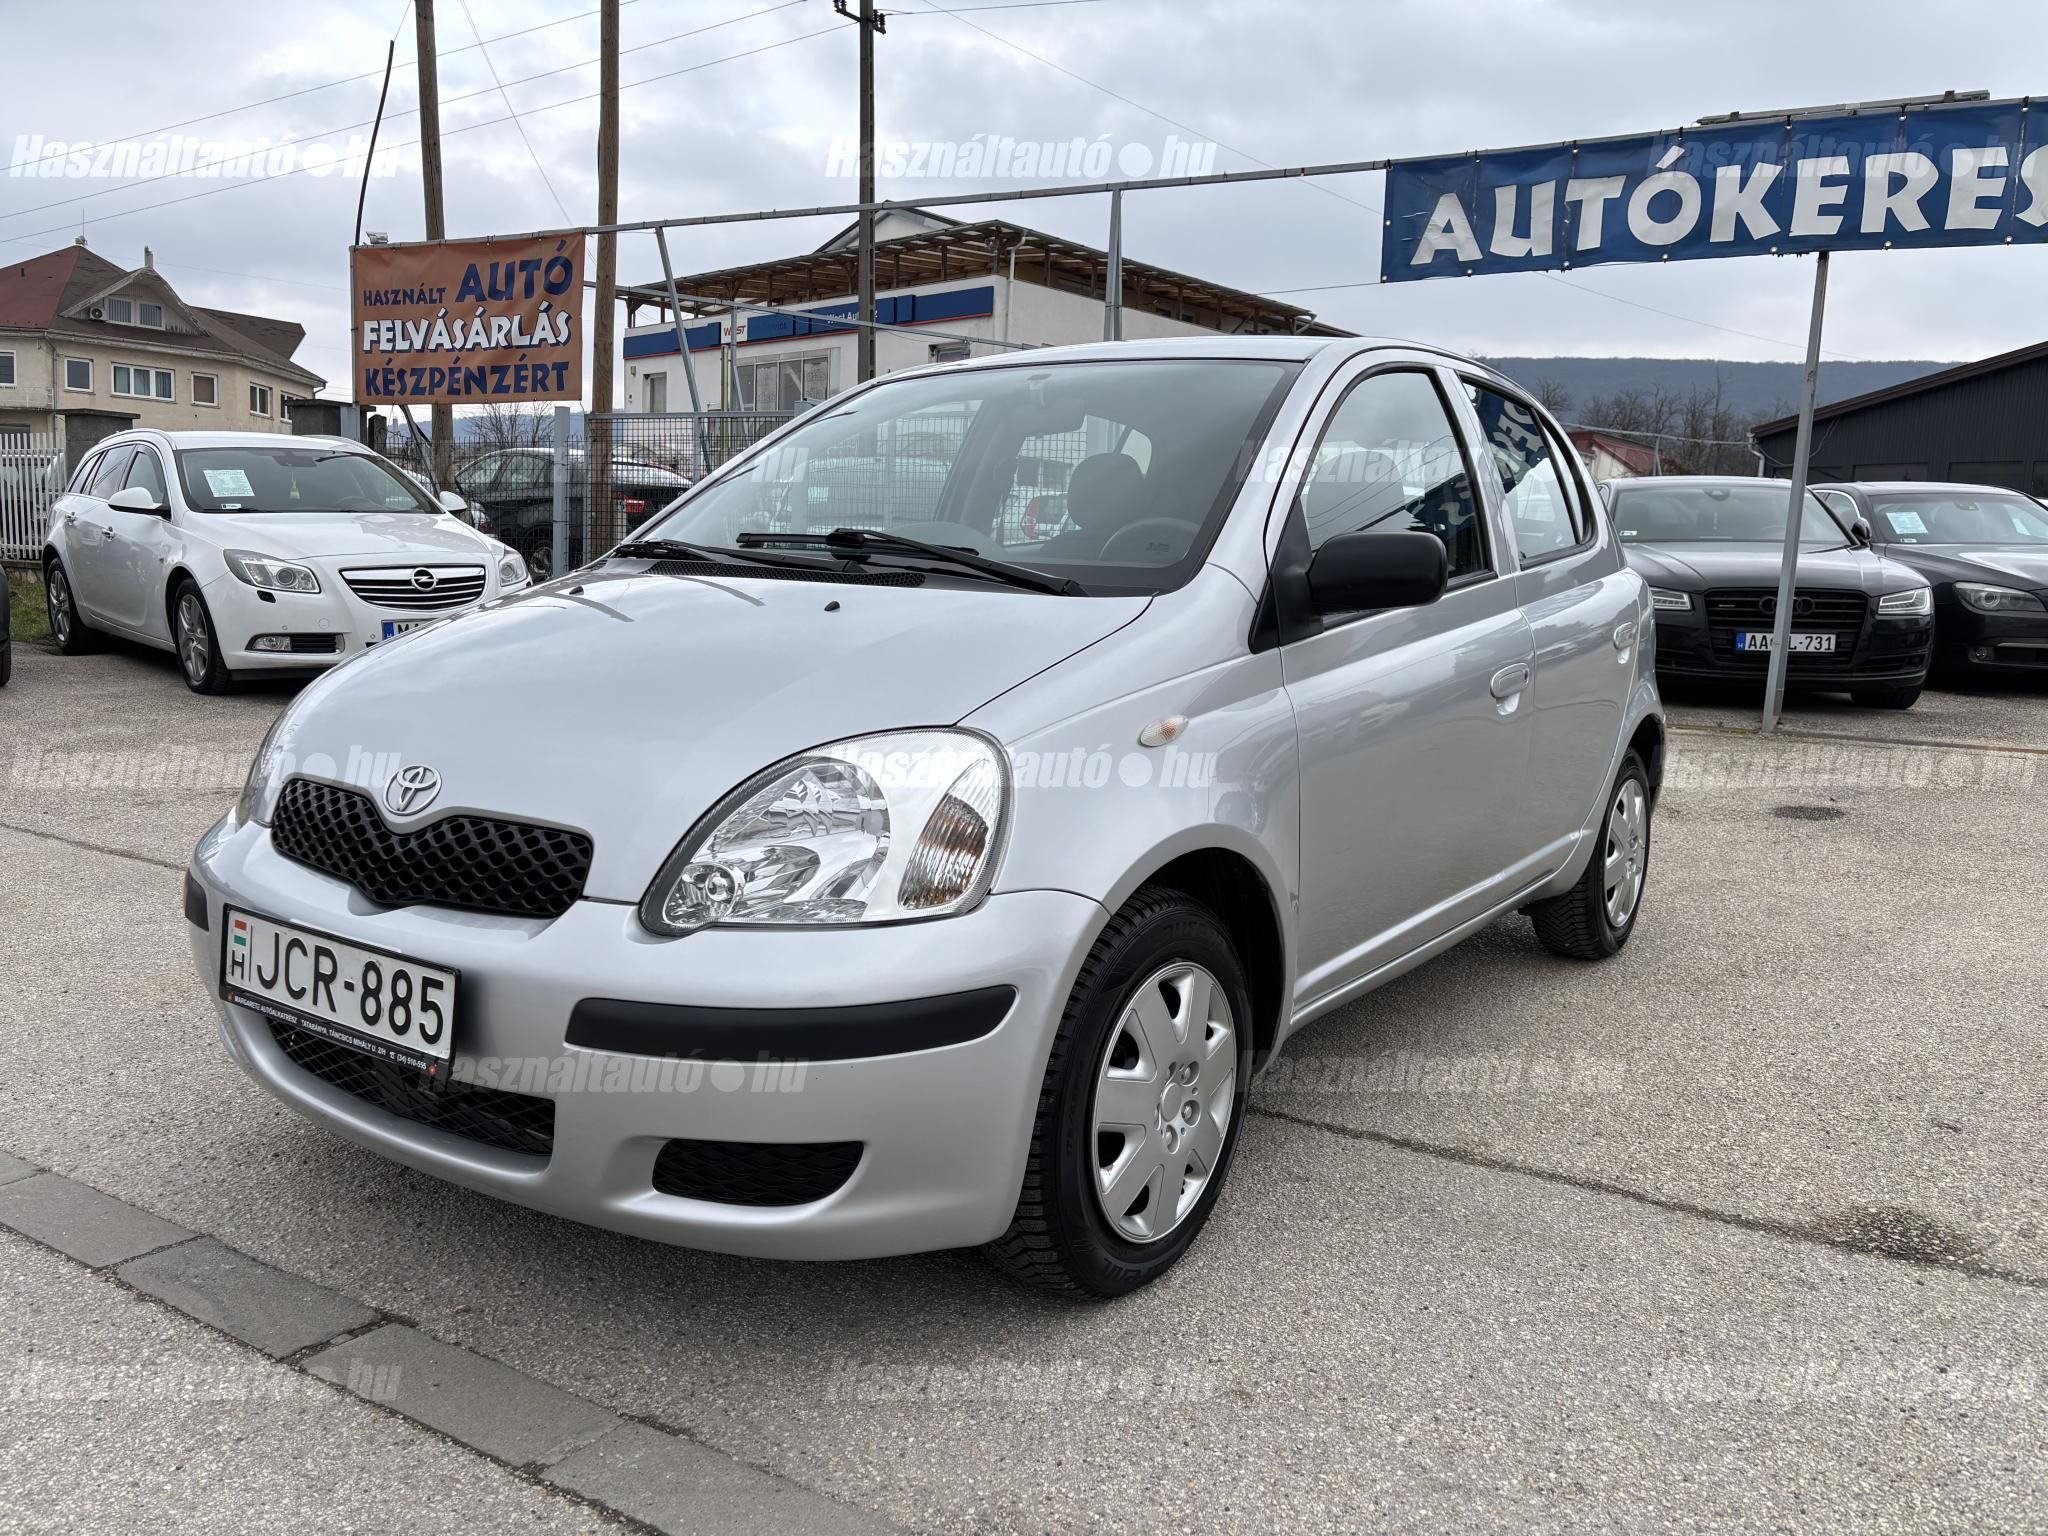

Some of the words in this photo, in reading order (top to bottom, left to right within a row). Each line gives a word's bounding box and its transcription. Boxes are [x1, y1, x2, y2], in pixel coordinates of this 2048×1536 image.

[363, 283, 447, 306] HASZNÁLT
[455, 240, 573, 303] AUTÓ
[363, 300, 572, 354] FELVÁSÁRLÁS
[724, 325, 747, 337] WST
[365, 353, 570, 396] KÉSZPÉNZÉRT
[231, 950, 245, 982] H
[257, 931, 444, 1045] JCR-885
